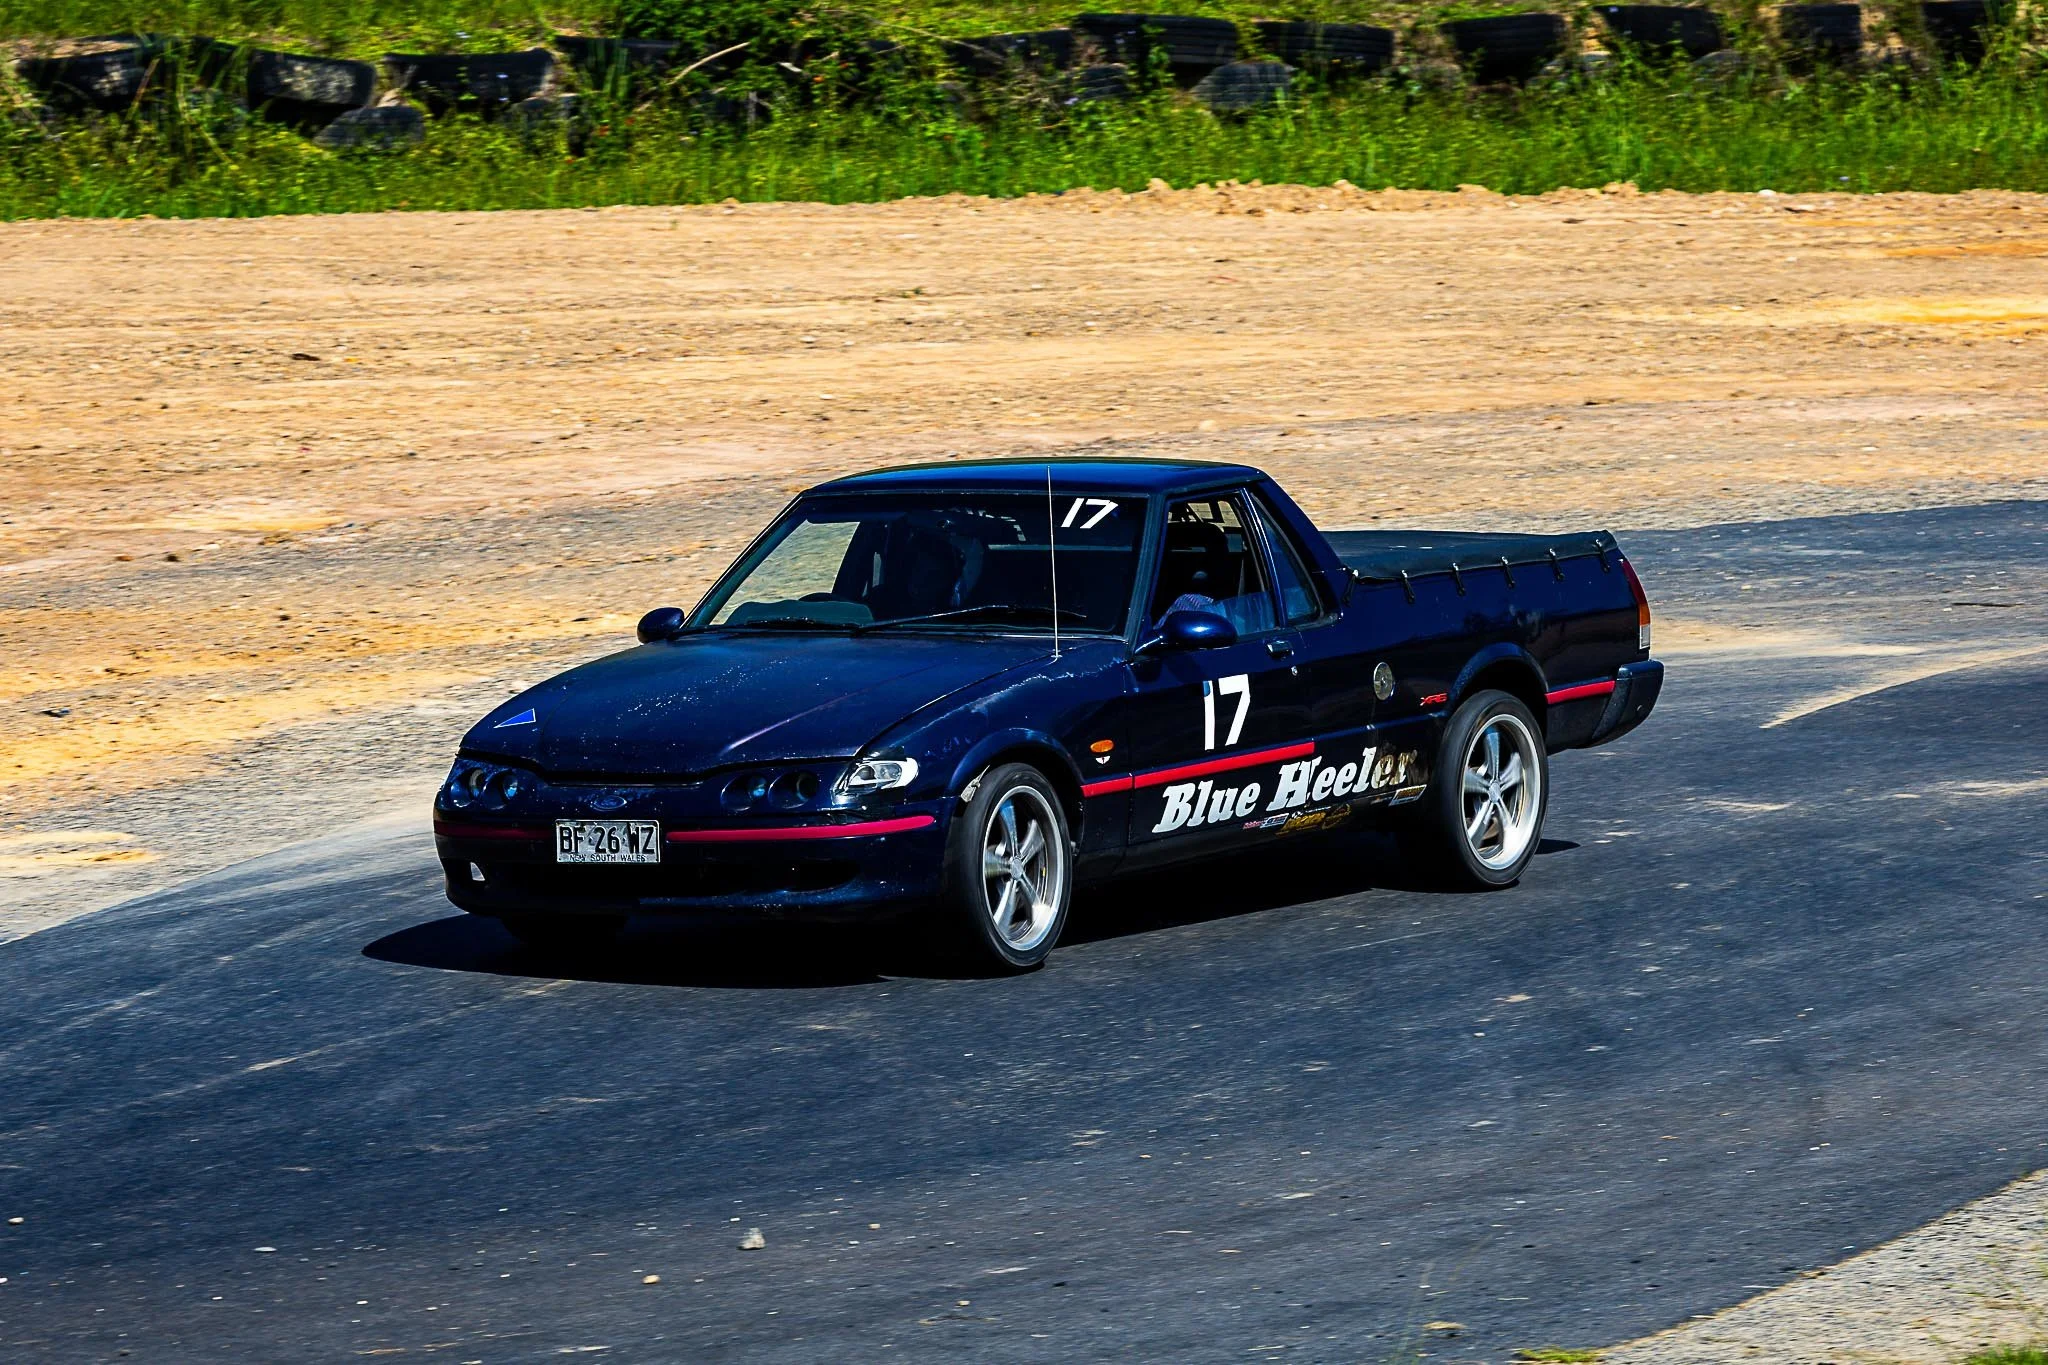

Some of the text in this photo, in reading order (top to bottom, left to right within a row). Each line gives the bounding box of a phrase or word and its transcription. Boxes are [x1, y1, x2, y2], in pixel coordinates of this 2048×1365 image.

[1060, 497, 1119, 529] 17
[1202, 673, 1252, 751] 17
[1151, 779, 1262, 834] Blue
[1265, 746, 1417, 812] Heeler
[590, 854, 617, 862] SOUTH
[620, 854, 647, 862] WALES
